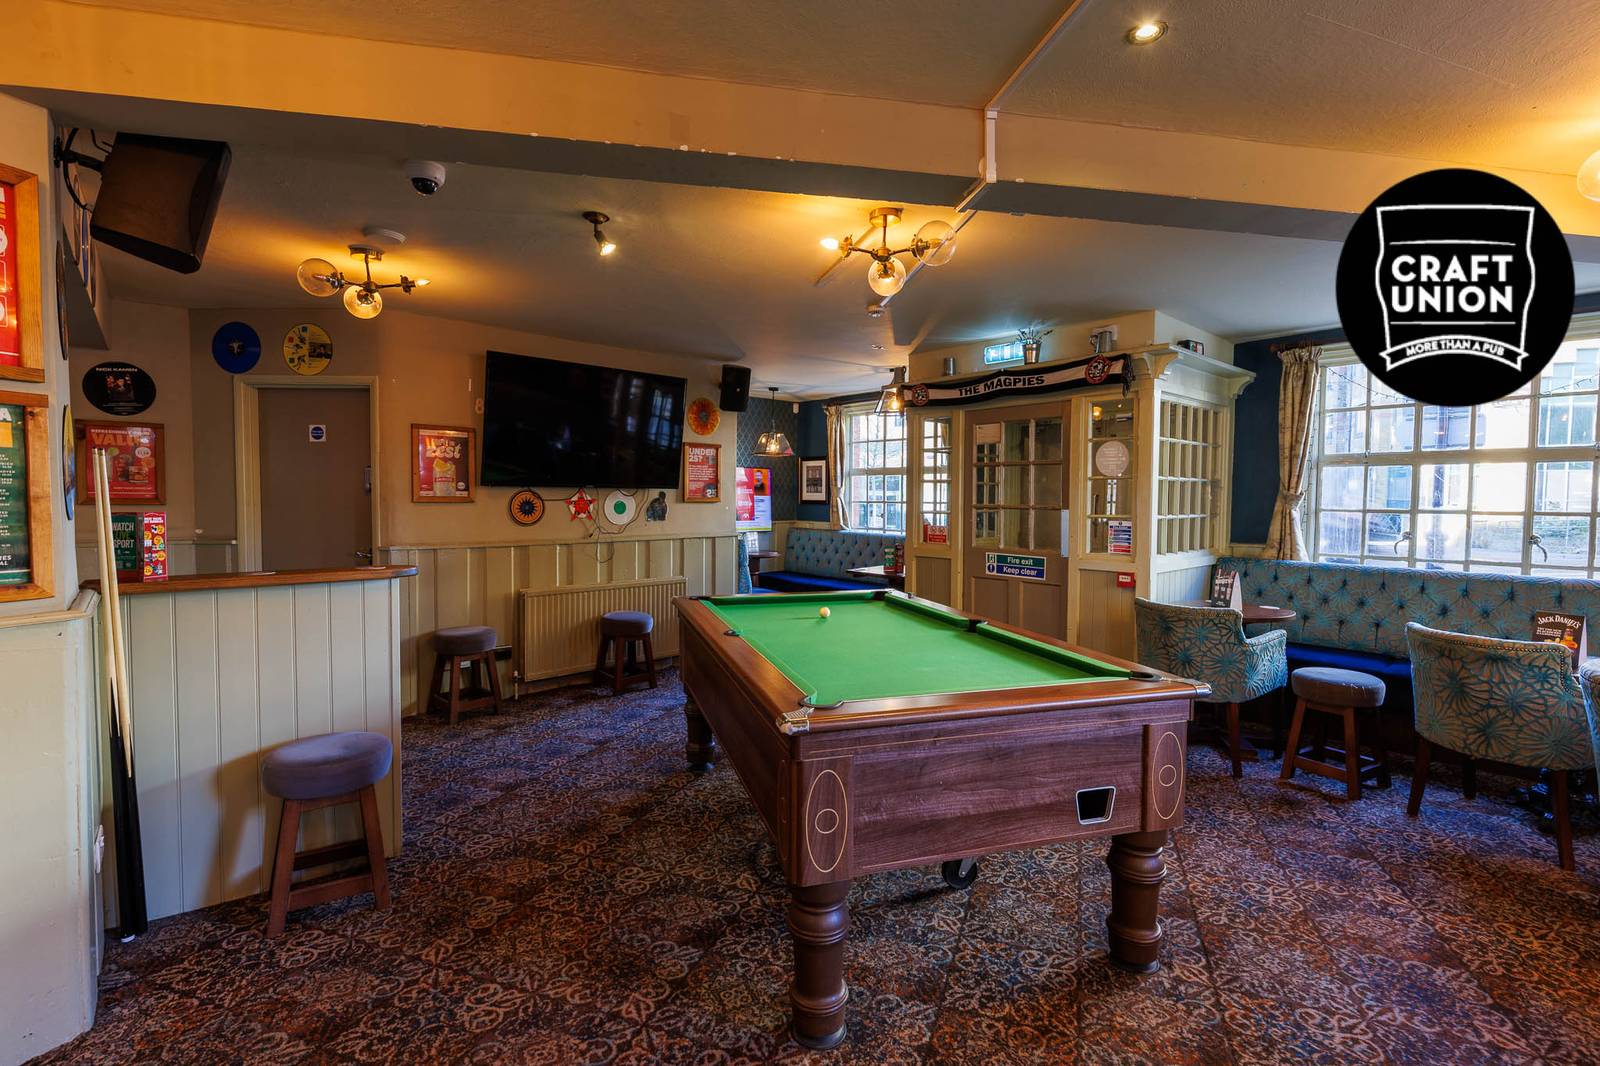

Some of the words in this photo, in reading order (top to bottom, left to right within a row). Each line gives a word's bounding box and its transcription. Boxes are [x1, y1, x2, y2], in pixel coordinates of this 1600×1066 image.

[958, 385, 980, 397] THE
[983, 375, 1045, 392] MAGPIES
[689, 447, 716, 456] UNDER
[112, 521, 135, 531] WATCH
[113, 539, 135, 549] SPORT
[1007, 556, 1020, 564] Fire
[1021, 558, 1034, 566] exit
[1003, 566, 1020, 576] Keep
[1020, 568, 1038, 576] clear
[1538, 616, 1555, 625] JACK
